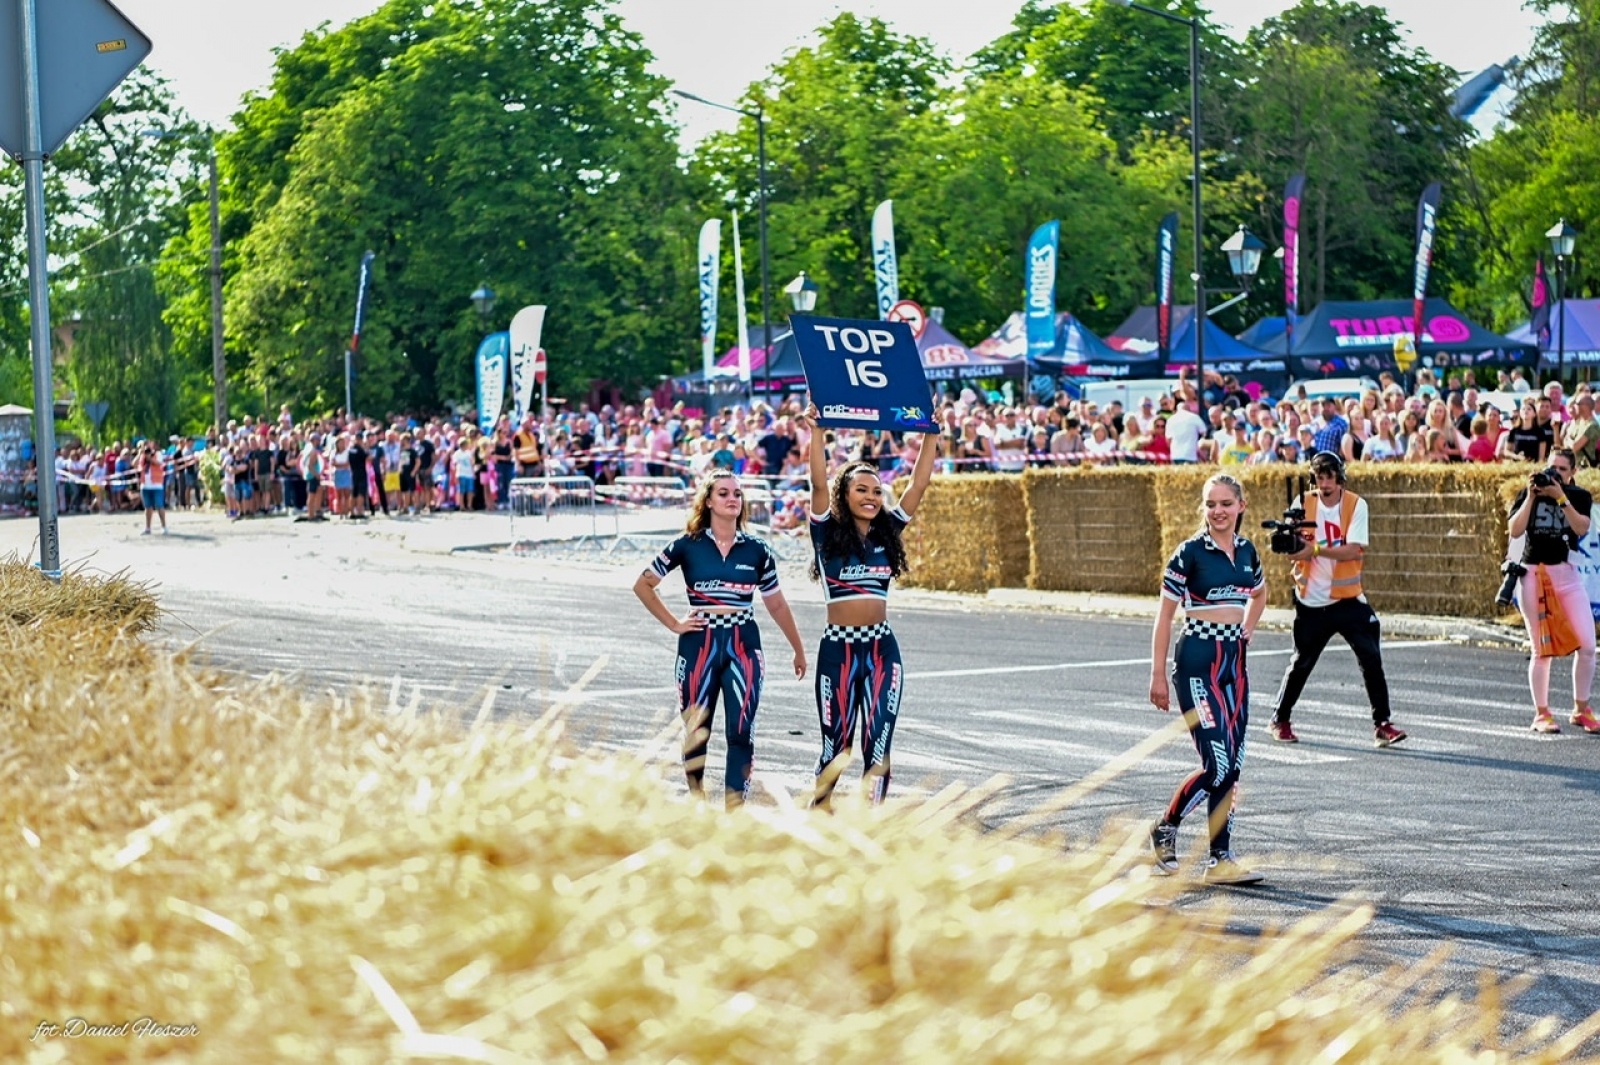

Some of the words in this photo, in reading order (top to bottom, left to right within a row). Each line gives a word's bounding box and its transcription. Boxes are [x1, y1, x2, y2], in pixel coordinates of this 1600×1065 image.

[813, 324, 895, 355] TOP
[924, 345, 969, 366] 85
[844, 358, 888, 389] 16
